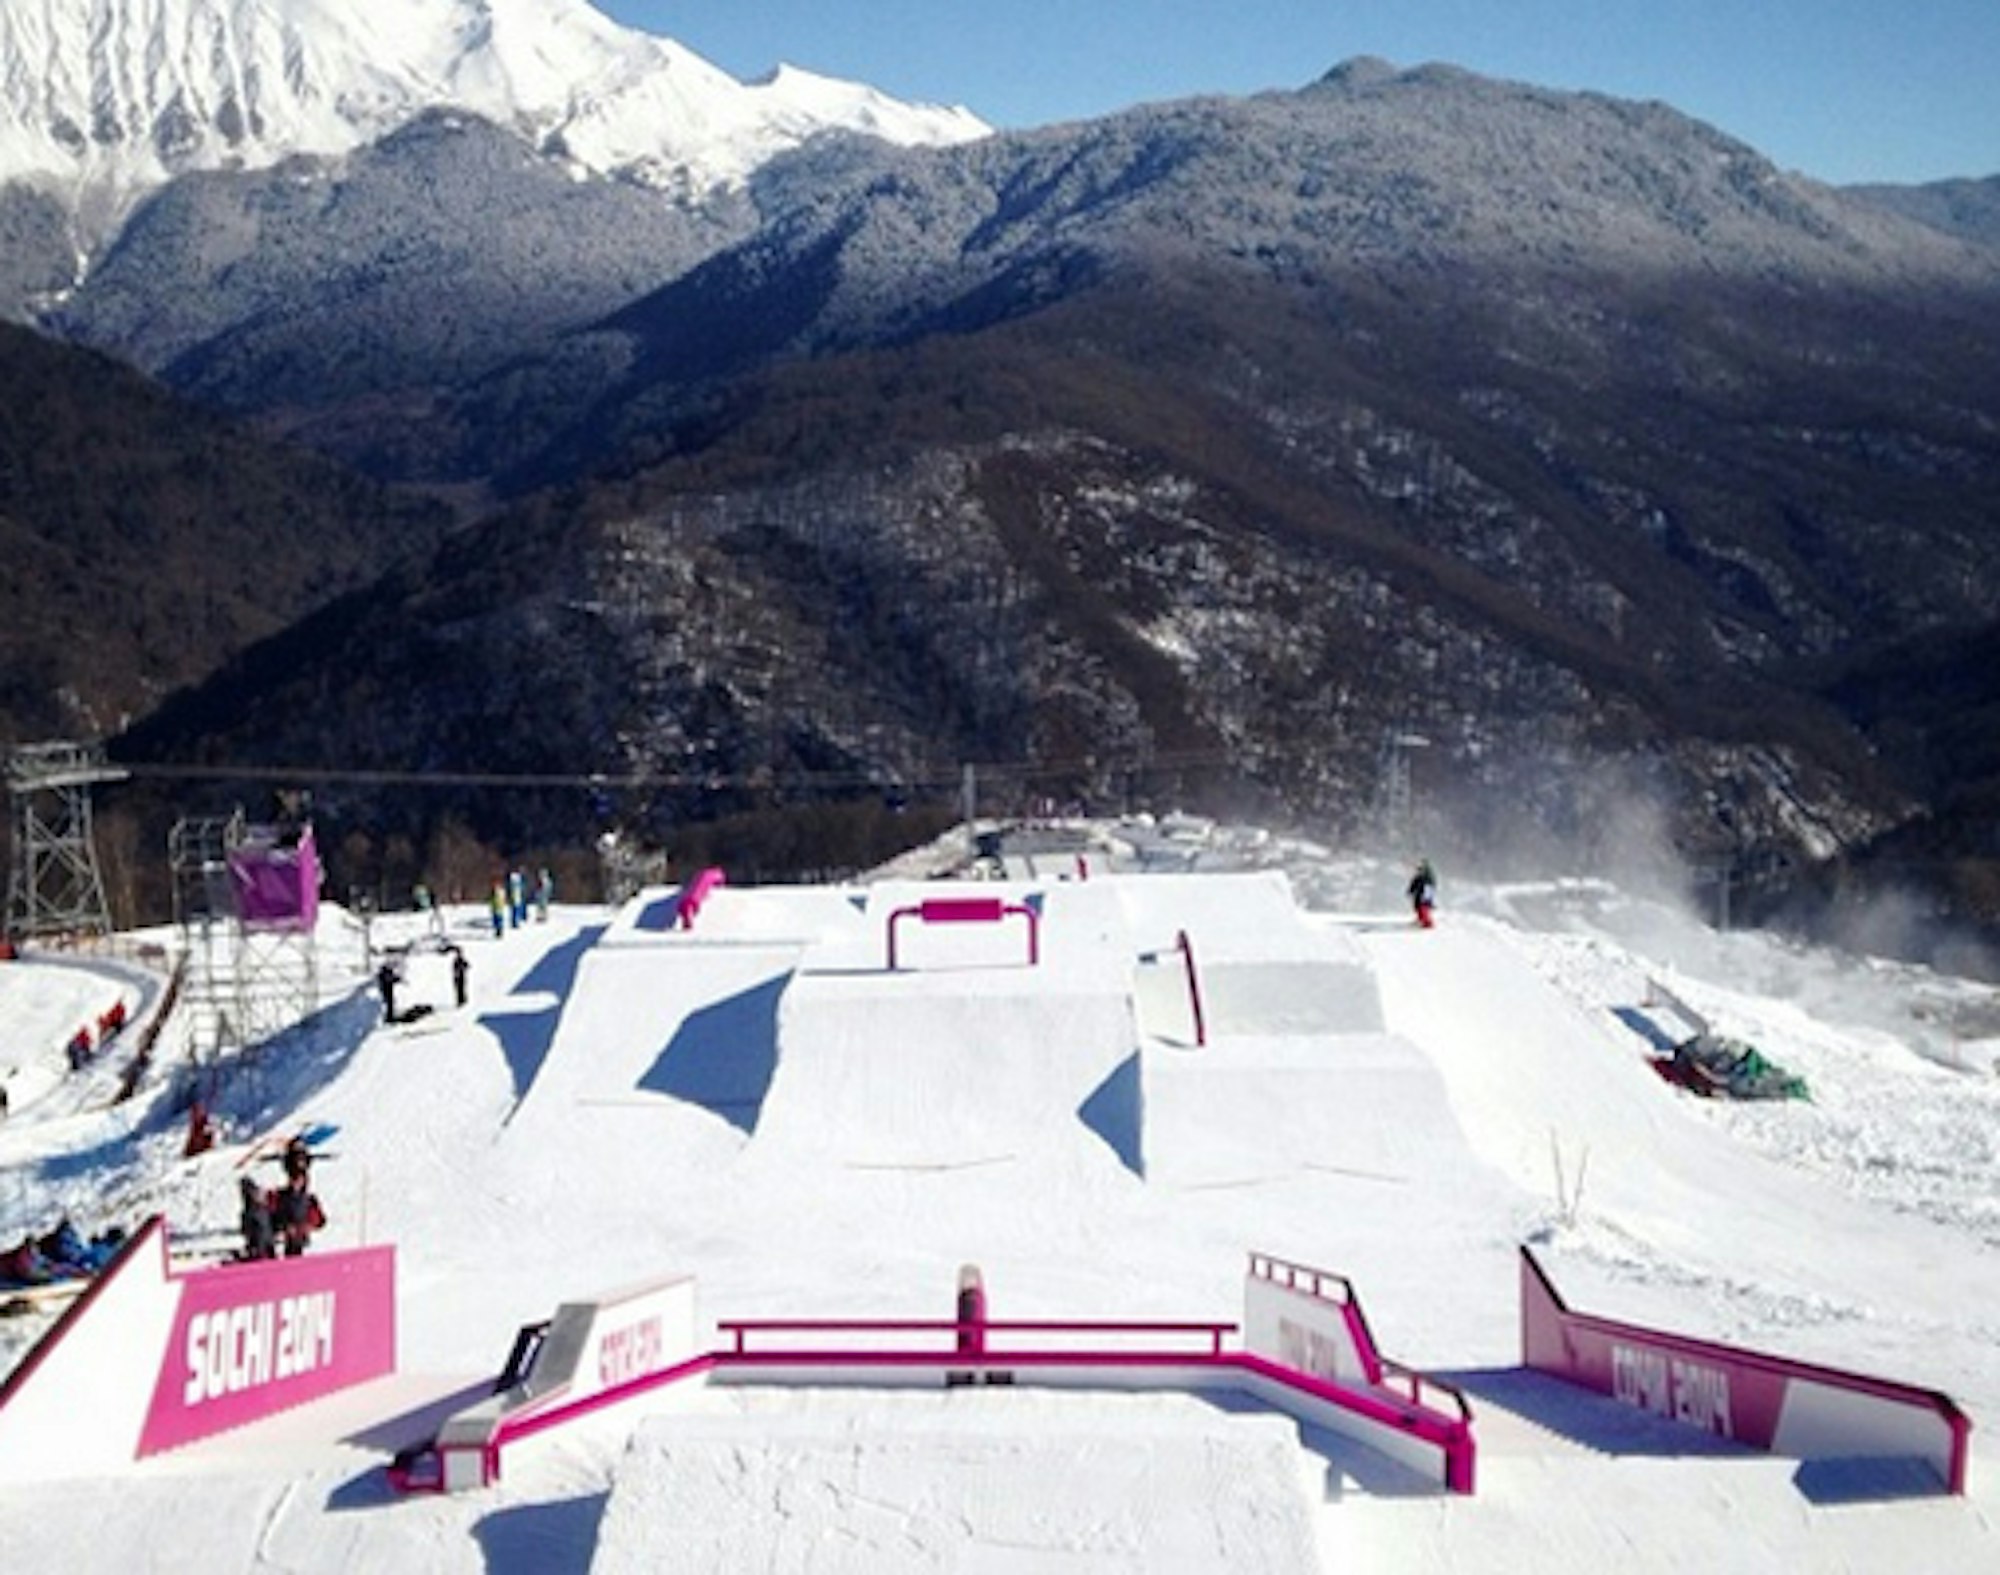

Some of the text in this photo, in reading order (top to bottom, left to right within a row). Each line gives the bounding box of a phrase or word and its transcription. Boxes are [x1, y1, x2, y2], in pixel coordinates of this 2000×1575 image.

[183, 1291, 335, 1407] SOCHI 2014
[1671, 1360, 1733, 1438] 2014
